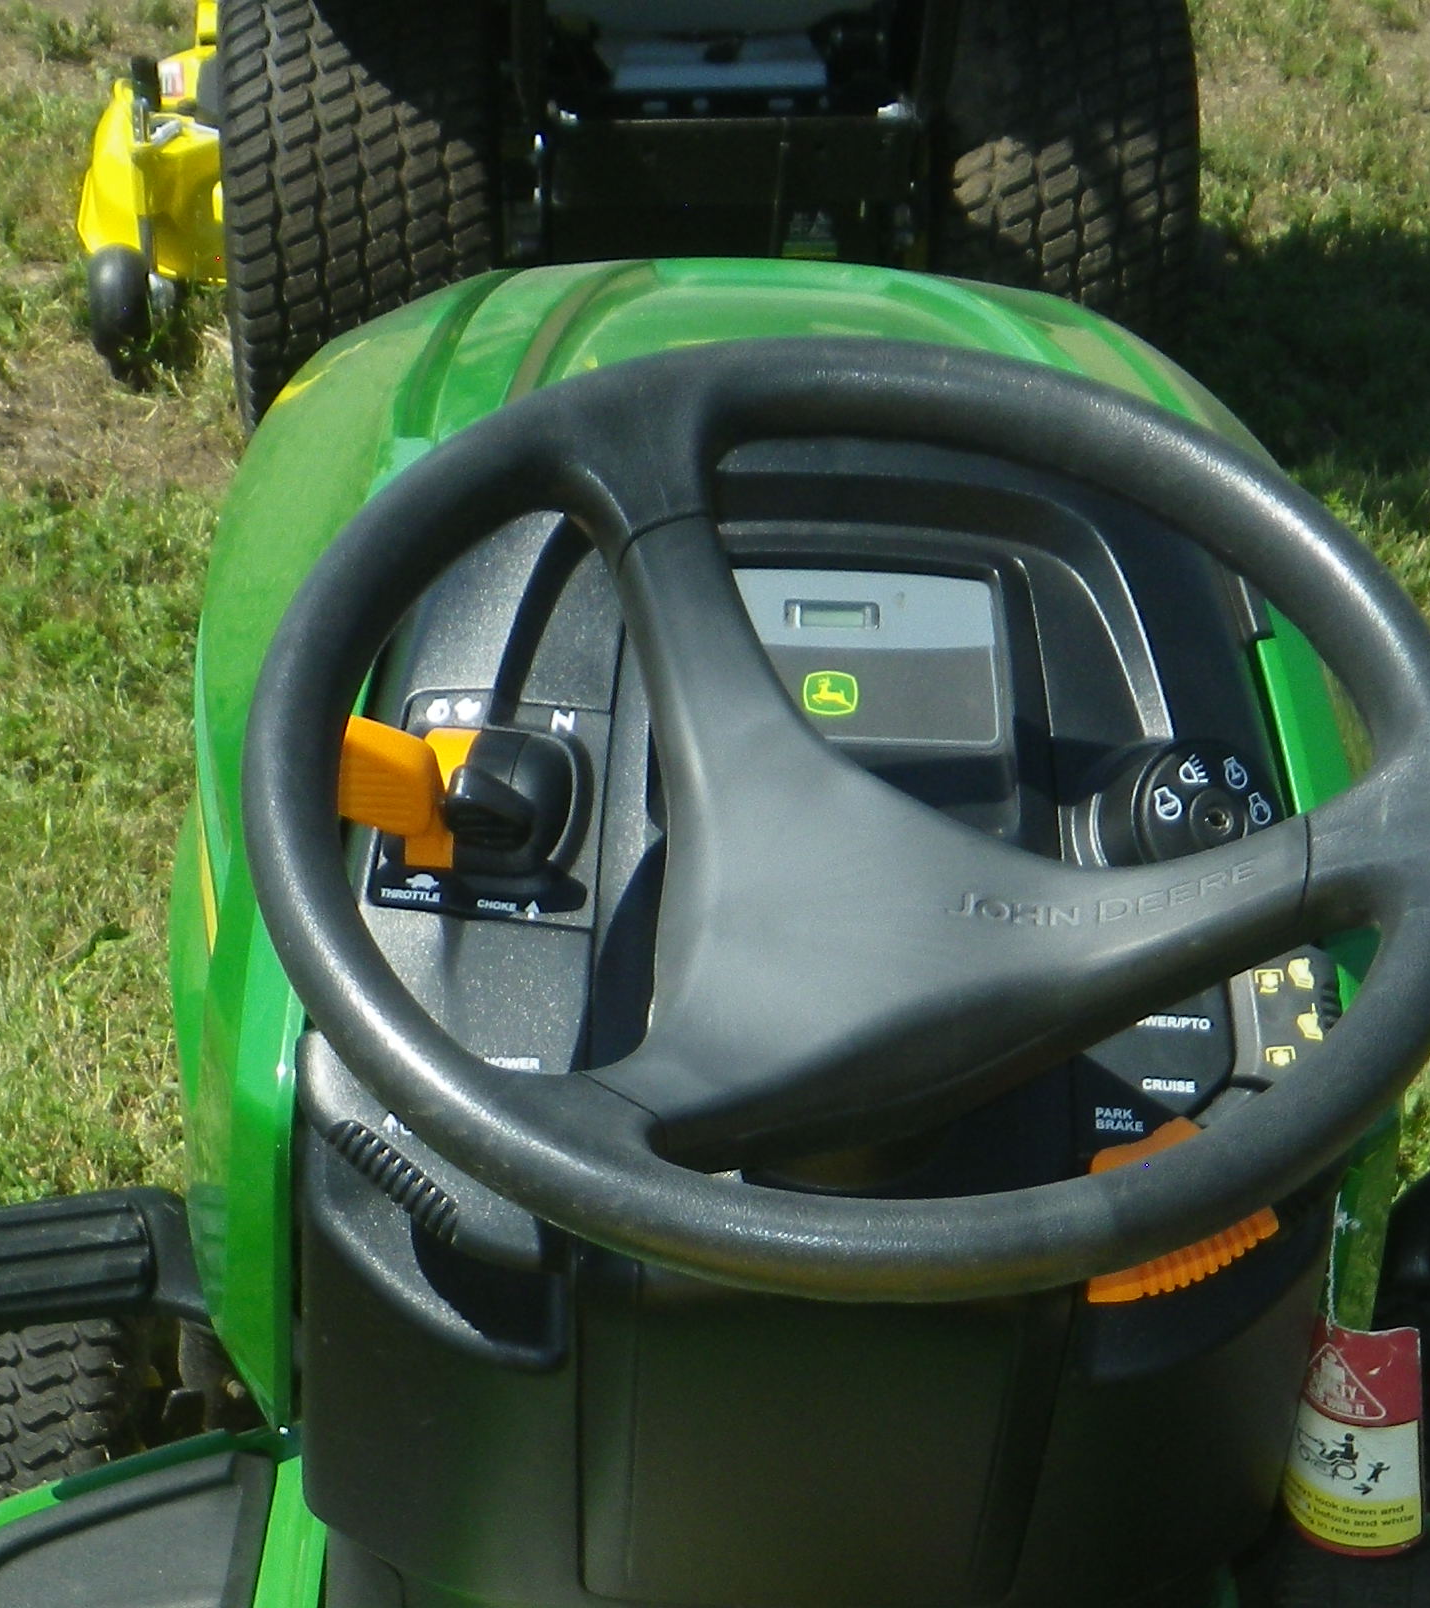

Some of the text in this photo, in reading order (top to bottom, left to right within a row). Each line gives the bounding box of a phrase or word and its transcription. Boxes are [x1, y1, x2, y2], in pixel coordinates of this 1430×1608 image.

[380, 888, 441, 902] THROTTLE
[947, 859, 1259, 927] JOHN DEERE
[476, 899, 518, 912] CHOKE
[1142, 1078, 1196, 1093] CRUISE
[1095, 1106, 1132, 1120] PARK
[1095, 1119, 1144, 1132] BRAKE
[1342, 1505, 1377, 1515] down
[1380, 1504, 1404, 1515] and
[1354, 1518, 1378, 1527] and
[1381, 1514, 1414, 1526] while
